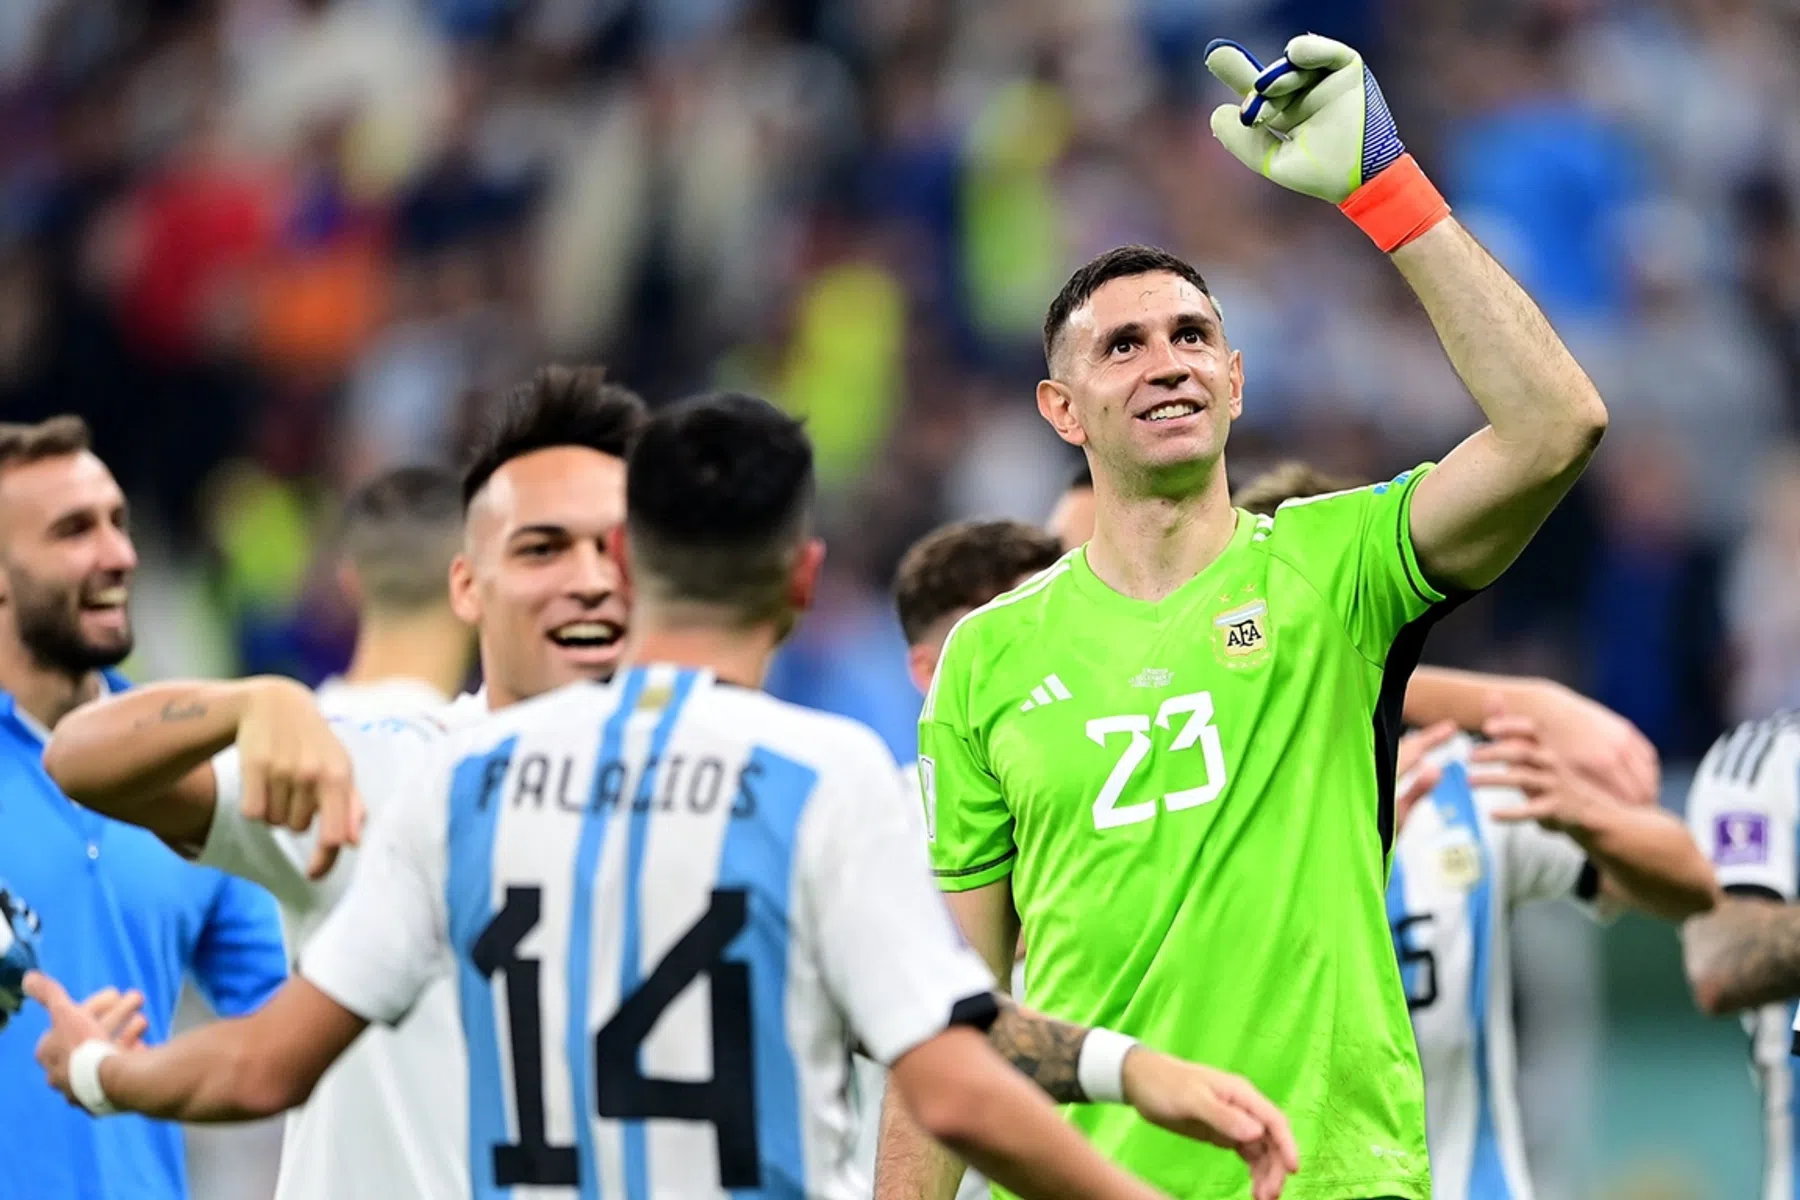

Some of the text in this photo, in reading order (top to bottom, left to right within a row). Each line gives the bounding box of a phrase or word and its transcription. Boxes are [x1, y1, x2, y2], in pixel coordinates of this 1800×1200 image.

[1227, 618, 1262, 647] AFA
[477, 751, 764, 819] PALACIOS
[1086, 690, 1227, 829] 23
[470, 885, 764, 1189] 14
